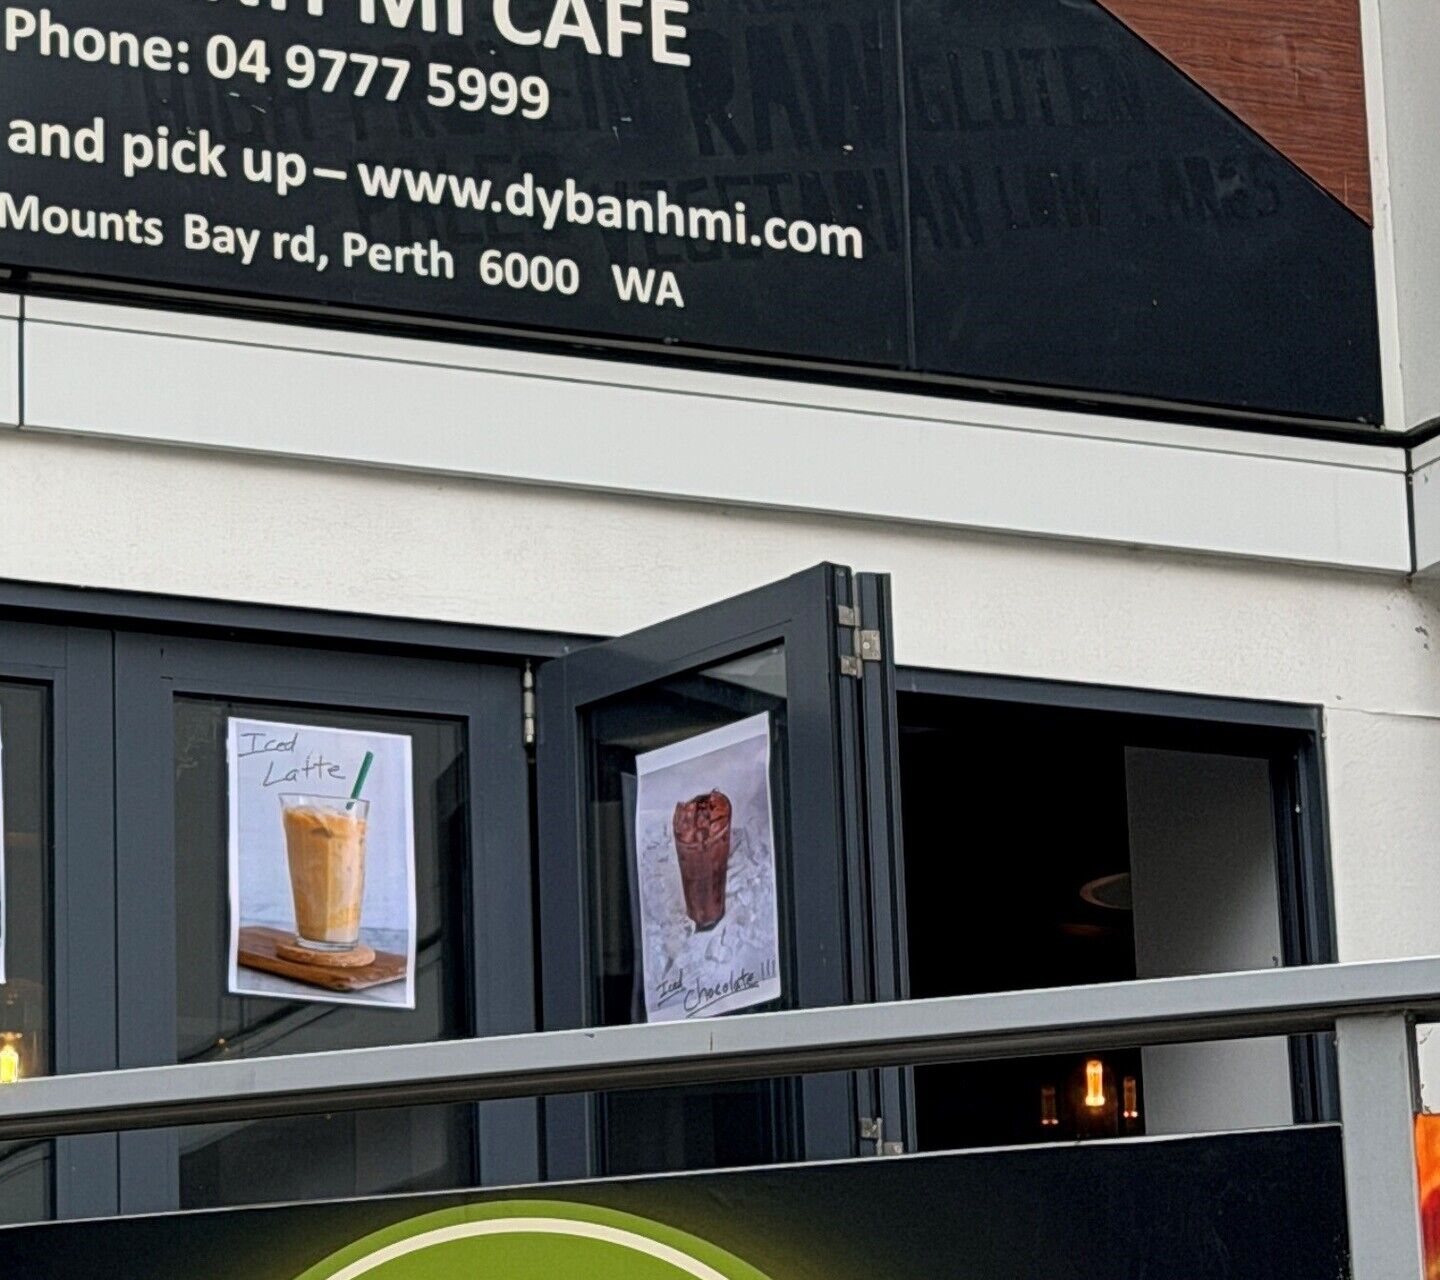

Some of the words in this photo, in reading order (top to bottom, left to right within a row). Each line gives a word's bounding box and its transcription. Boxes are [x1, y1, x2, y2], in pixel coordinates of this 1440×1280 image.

[5, 7, 190, 75] Phone:
[206, 34, 271, 83] 04
[285, 44, 410, 101] 9777
[427, 62, 549, 120] 5999
[7, 117, 104, 164] and
[123, 126, 227, 184] pick
[357, 163, 863, 259] www.dybanhmi.com
[184, 213, 260, 265] Bay
[273, 224, 329, 272] rd,
[343, 231, 454, 279] Perth
[479, 249, 579, 295] 6000
[611, 264, 684, 308] WA
[238, 731, 299, 758] Iced
[262, 751, 347, 787] Latte
